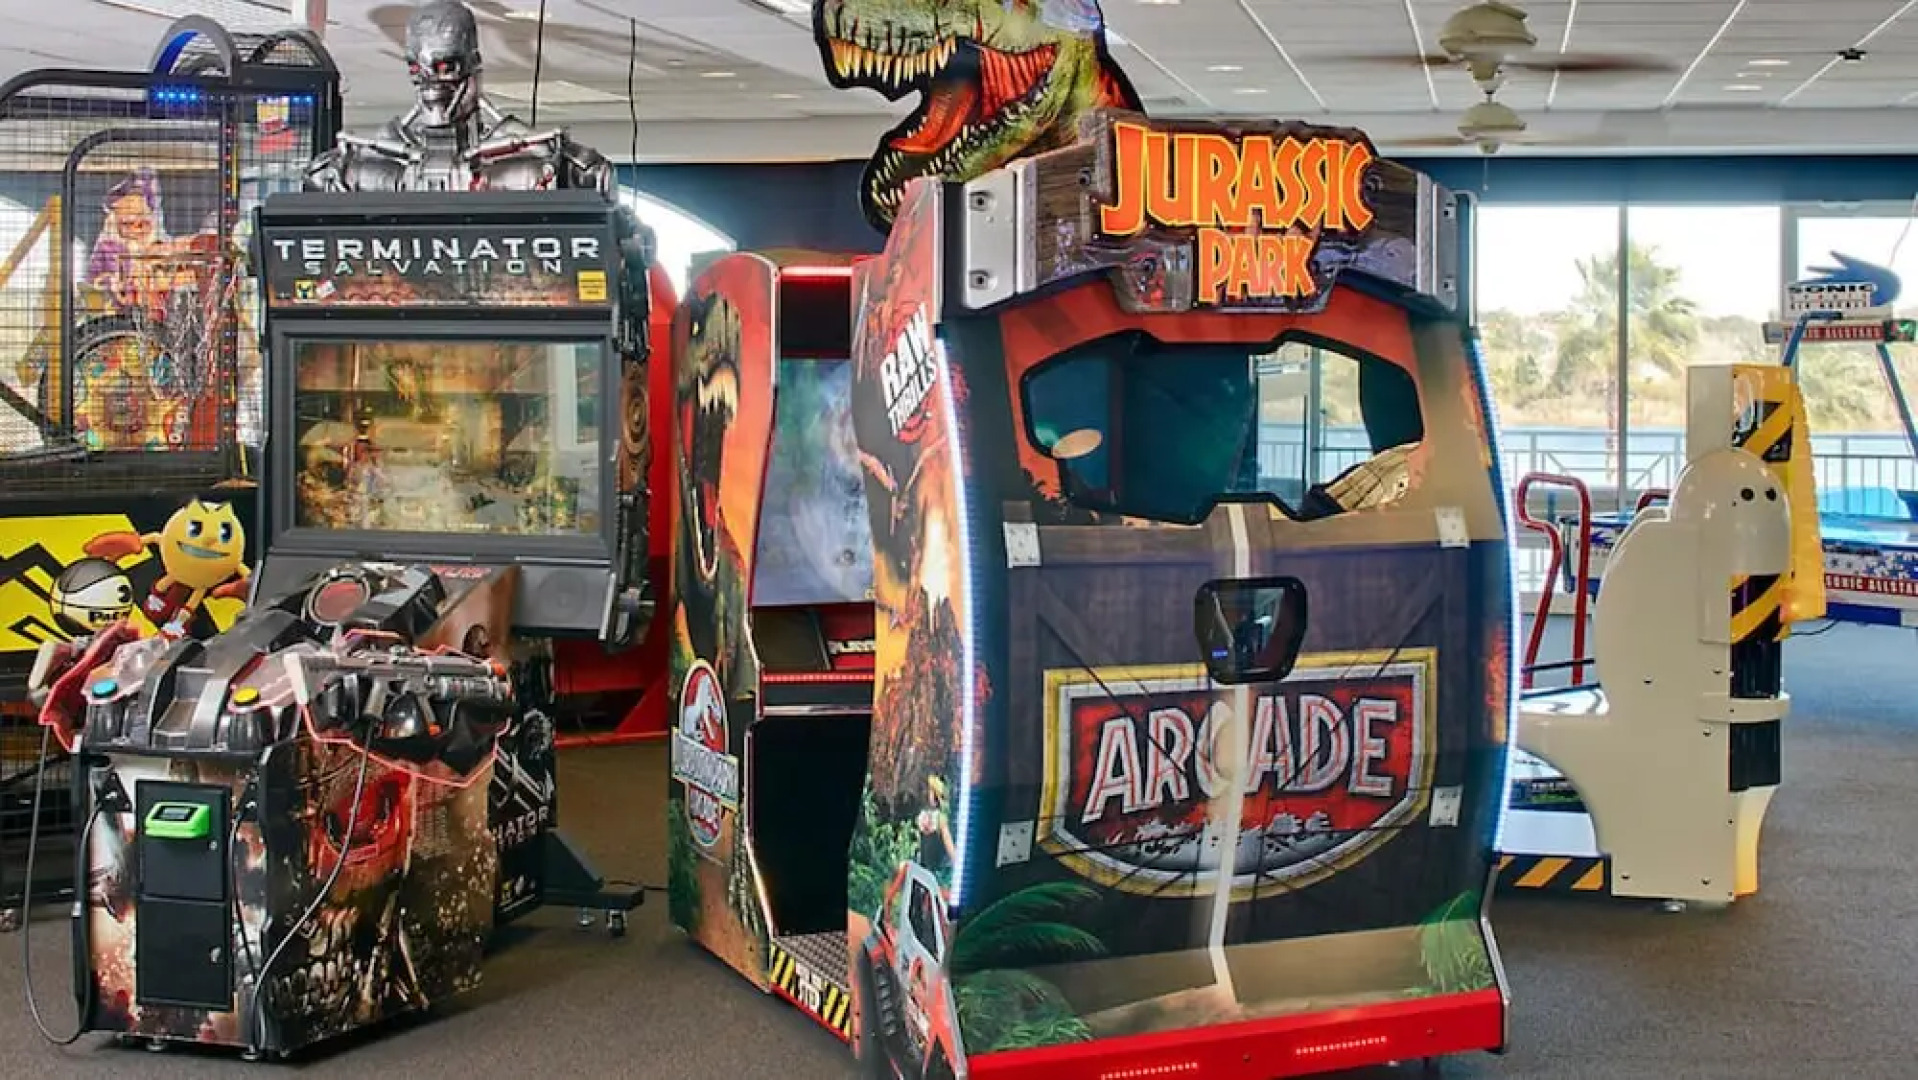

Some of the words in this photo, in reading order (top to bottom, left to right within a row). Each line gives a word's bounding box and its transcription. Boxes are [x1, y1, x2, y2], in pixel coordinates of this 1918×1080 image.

[1101, 122, 1373, 234] JURASSIC
[273, 238, 599, 259] TERMINATOR
[304, 260, 562, 275] SALVATION
[1198, 227, 1315, 303] PARK
[1789, 283, 1872, 294] SONIC
[880, 302, 930, 410] RAW
[887, 352, 937, 437] THRILLS
[1081, 694, 1397, 824] ARCADE
